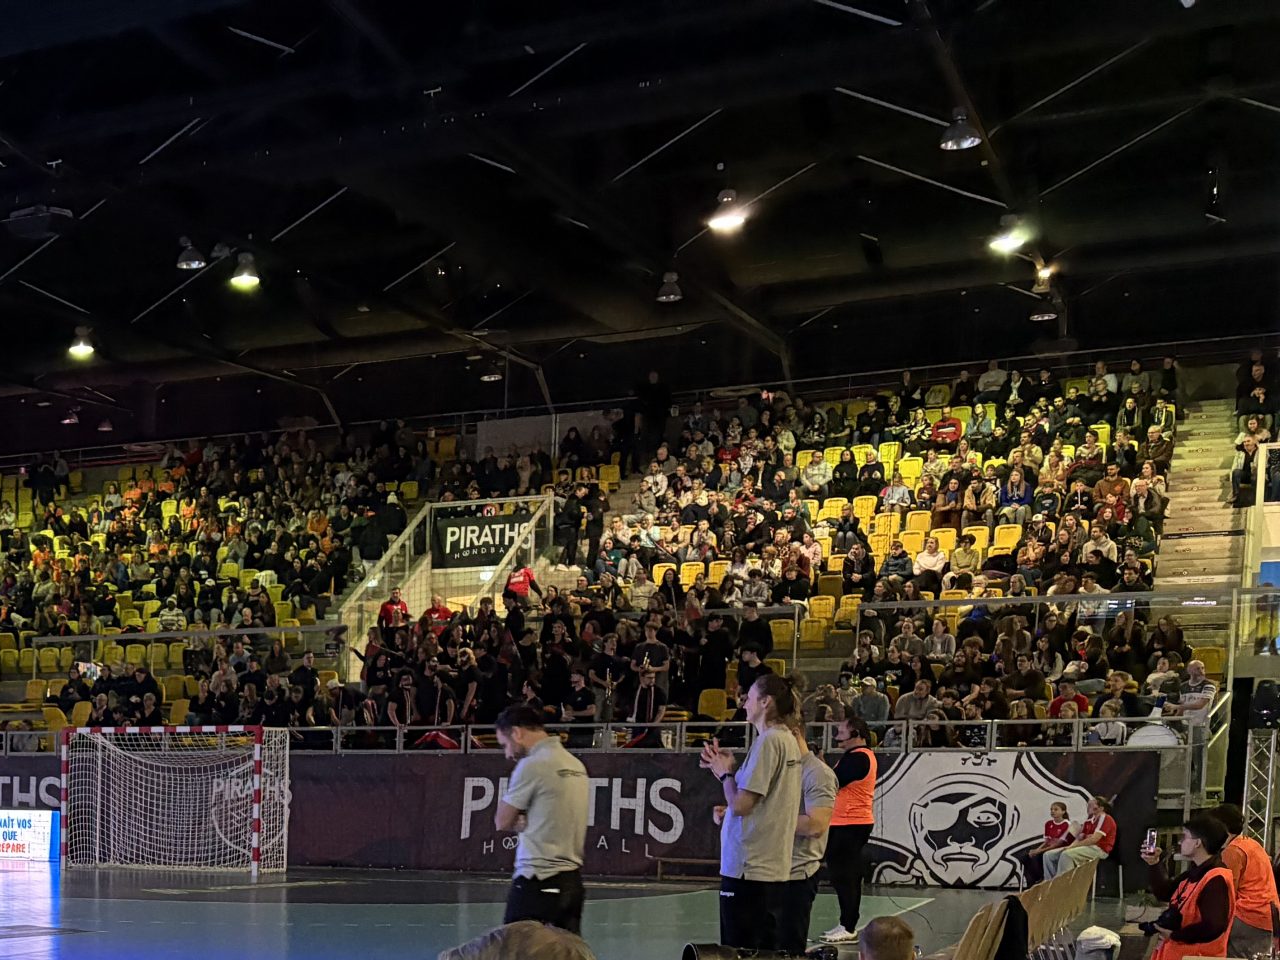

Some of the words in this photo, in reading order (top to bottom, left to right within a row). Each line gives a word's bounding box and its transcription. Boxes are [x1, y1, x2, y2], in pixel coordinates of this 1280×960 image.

[447, 523, 530, 553] PIRATHS
[17, 819, 32, 829] VOS
[2, 830, 18, 841] QUE
